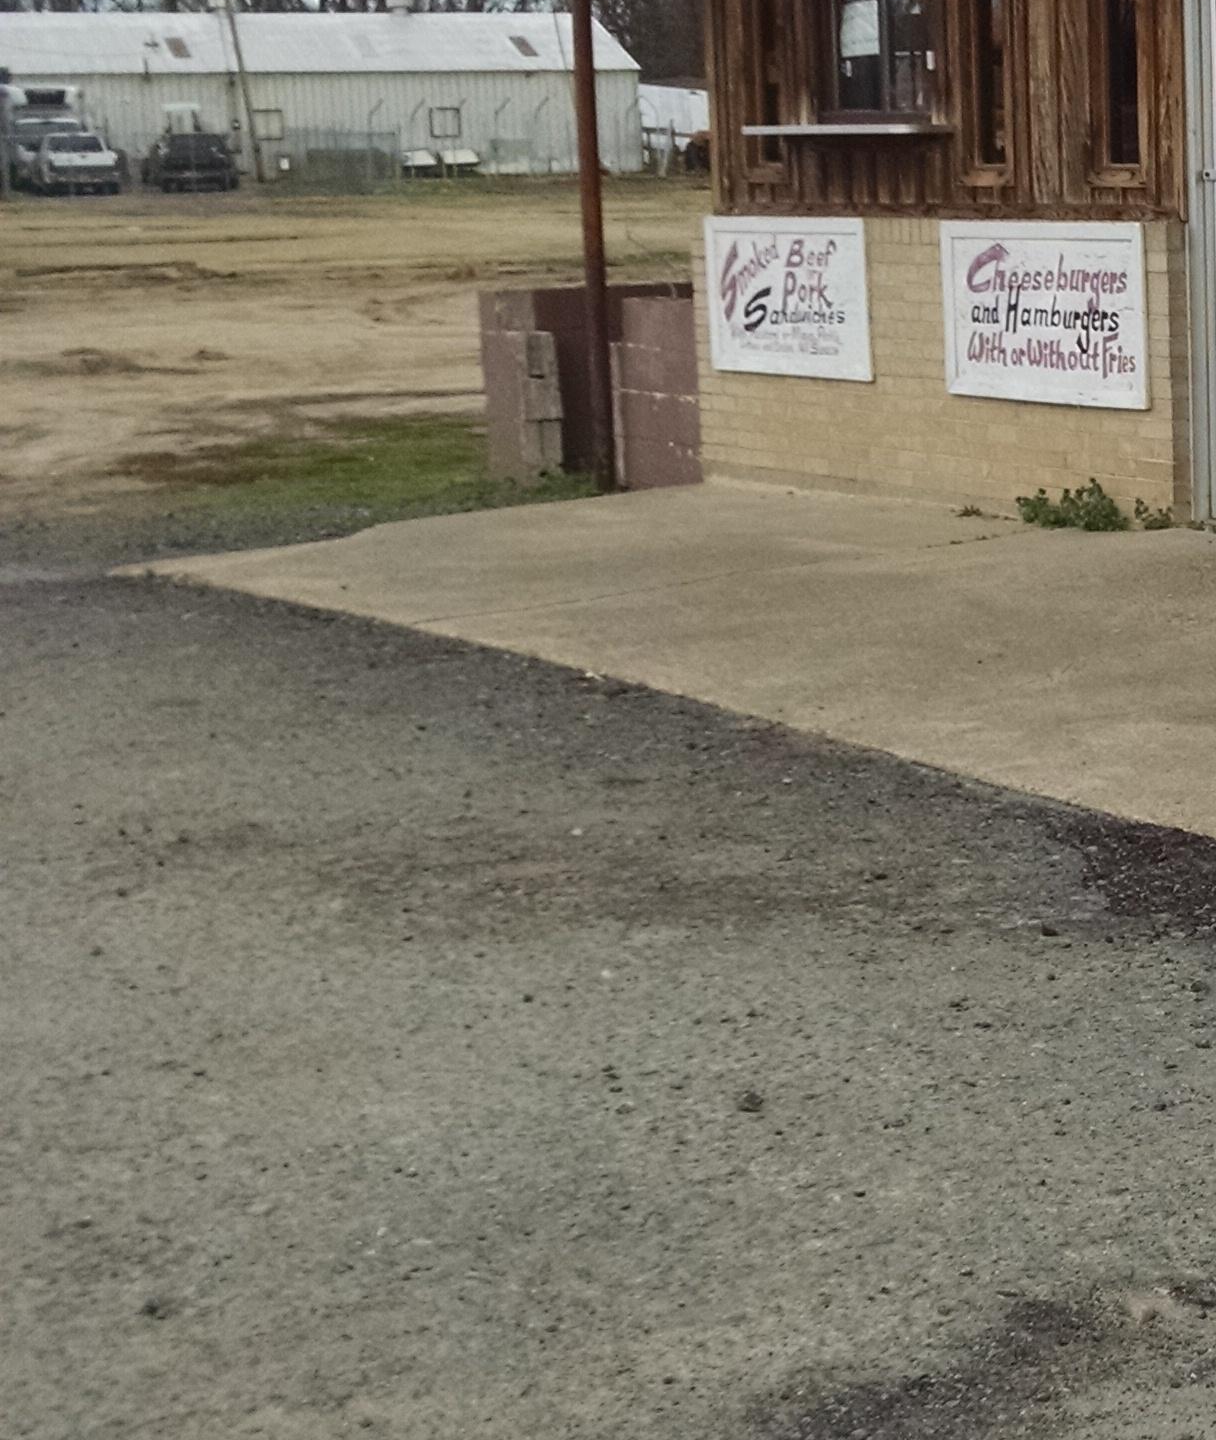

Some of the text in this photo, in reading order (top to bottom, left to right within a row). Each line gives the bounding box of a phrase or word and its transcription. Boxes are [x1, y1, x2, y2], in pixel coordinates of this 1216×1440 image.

[785, 238, 837, 268] Beef
[966, 242, 1128, 310] Cheeseburgers
[782, 270, 833, 311] Pork
[971, 283, 1120, 354] and Hamburgers
[967, 331, 1136, 379] With or Without Fries
